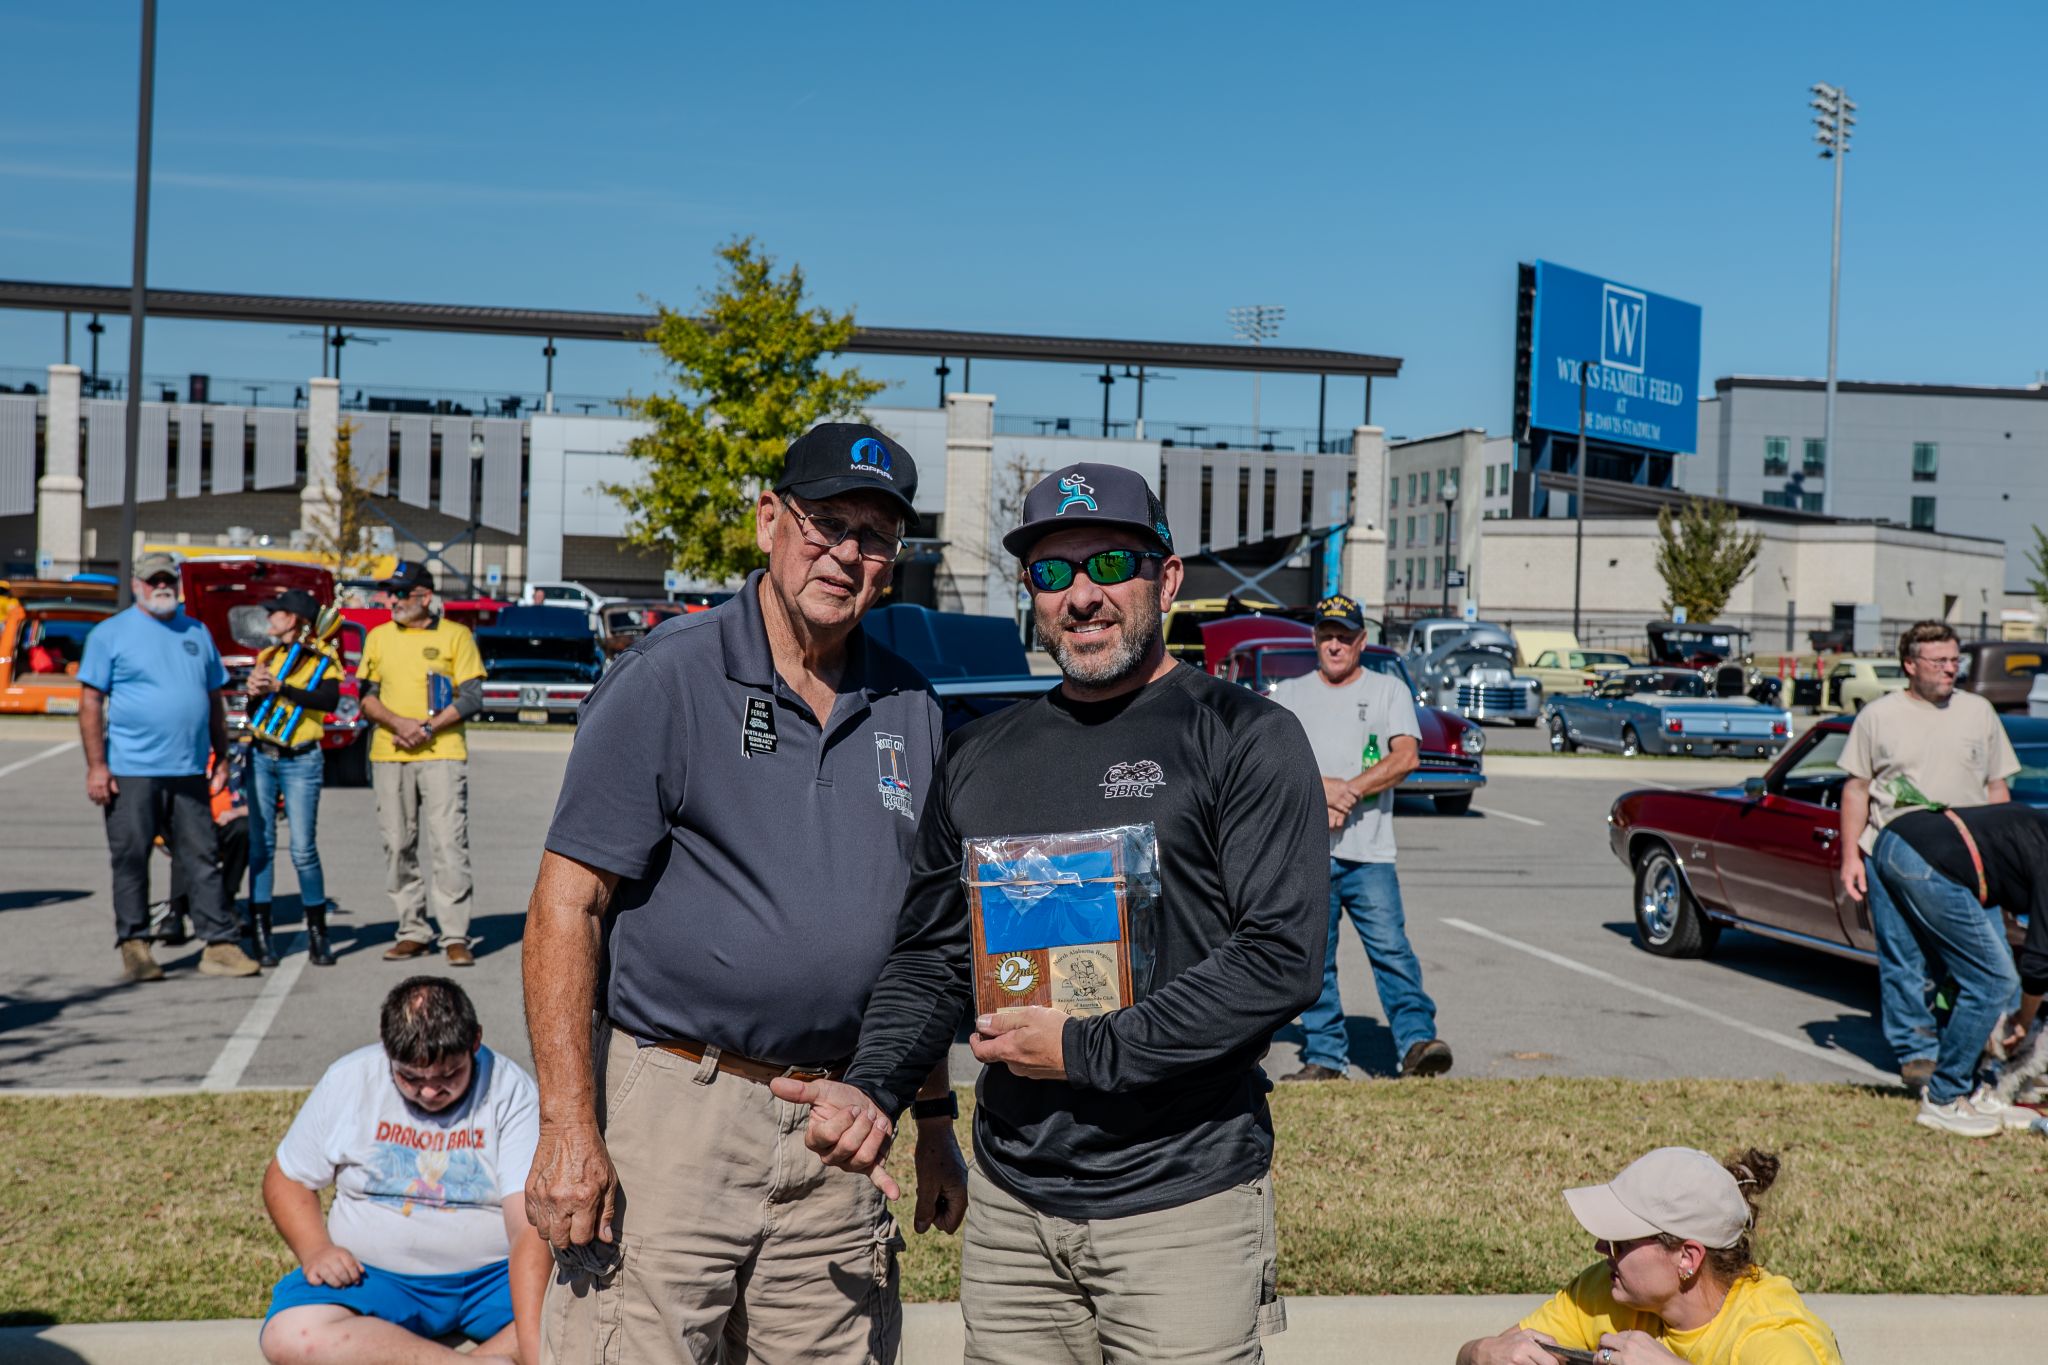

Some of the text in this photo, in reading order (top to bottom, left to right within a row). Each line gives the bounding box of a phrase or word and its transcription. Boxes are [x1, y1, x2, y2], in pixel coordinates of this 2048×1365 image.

[1608, 297, 1641, 358] W
[1602, 367, 1648, 400] FAMILY
[1649, 377, 1684, 407] FIELD
[1615, 397, 1628, 414] AT
[1595, 413, 1622, 433] DAVIS
[1622, 418, 1661, 442] STADIUM
[850, 463, 893, 480] MOPAR
[754, 701, 766, 709] BOB
[750, 709, 769, 719] FERENC
[1104, 783, 1155, 799] SBRC
[1052, 952, 1069, 966] North
[375, 1120, 446, 1152] DRAGON
